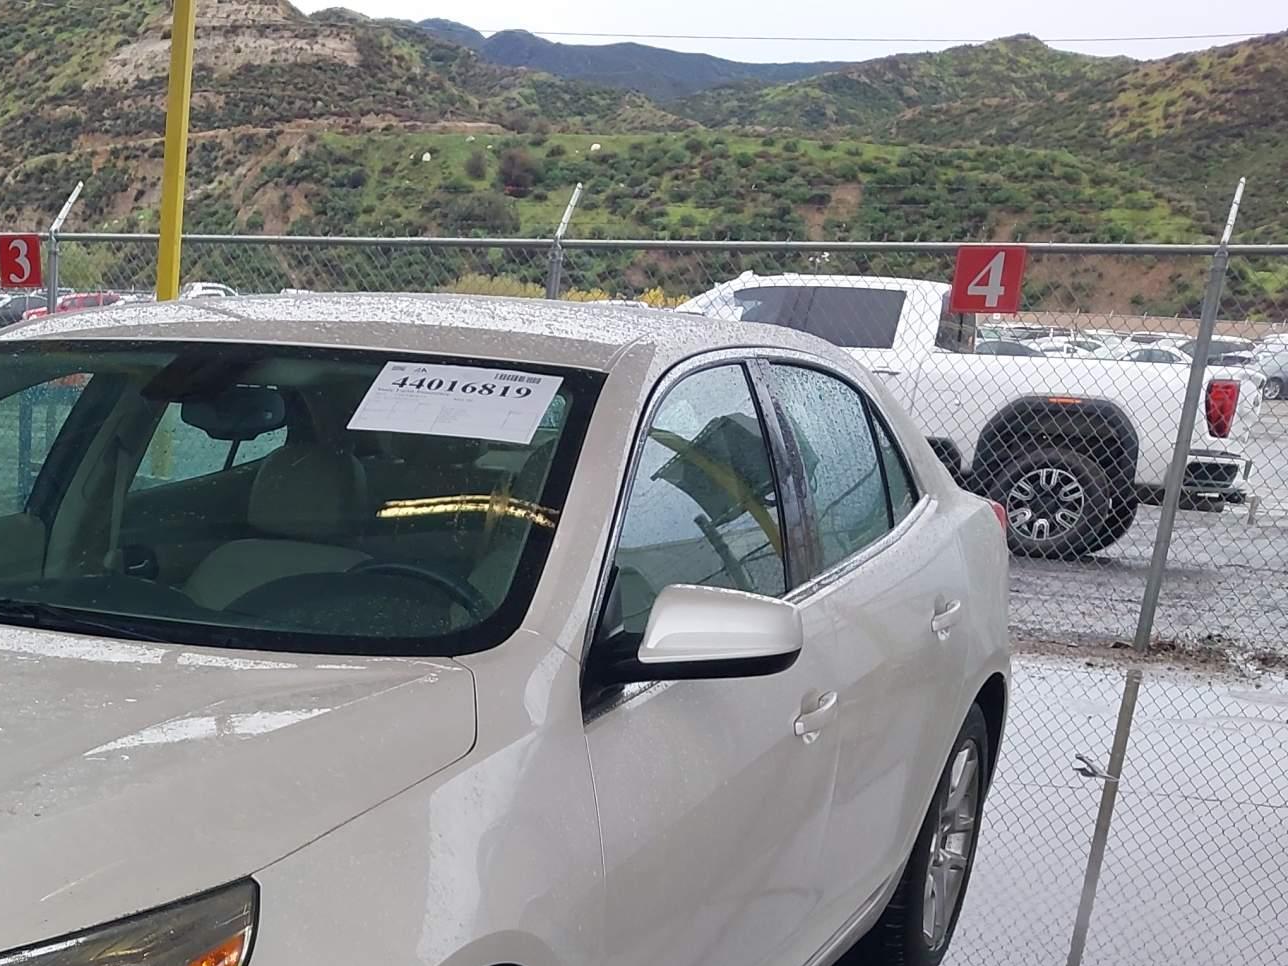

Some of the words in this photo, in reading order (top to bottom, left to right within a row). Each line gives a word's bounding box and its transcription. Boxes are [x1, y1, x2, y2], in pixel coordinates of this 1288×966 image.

[8, 239, 31, 283] 3
[967, 251, 1005, 307] 4
[391, 375, 532, 399] 44016819
